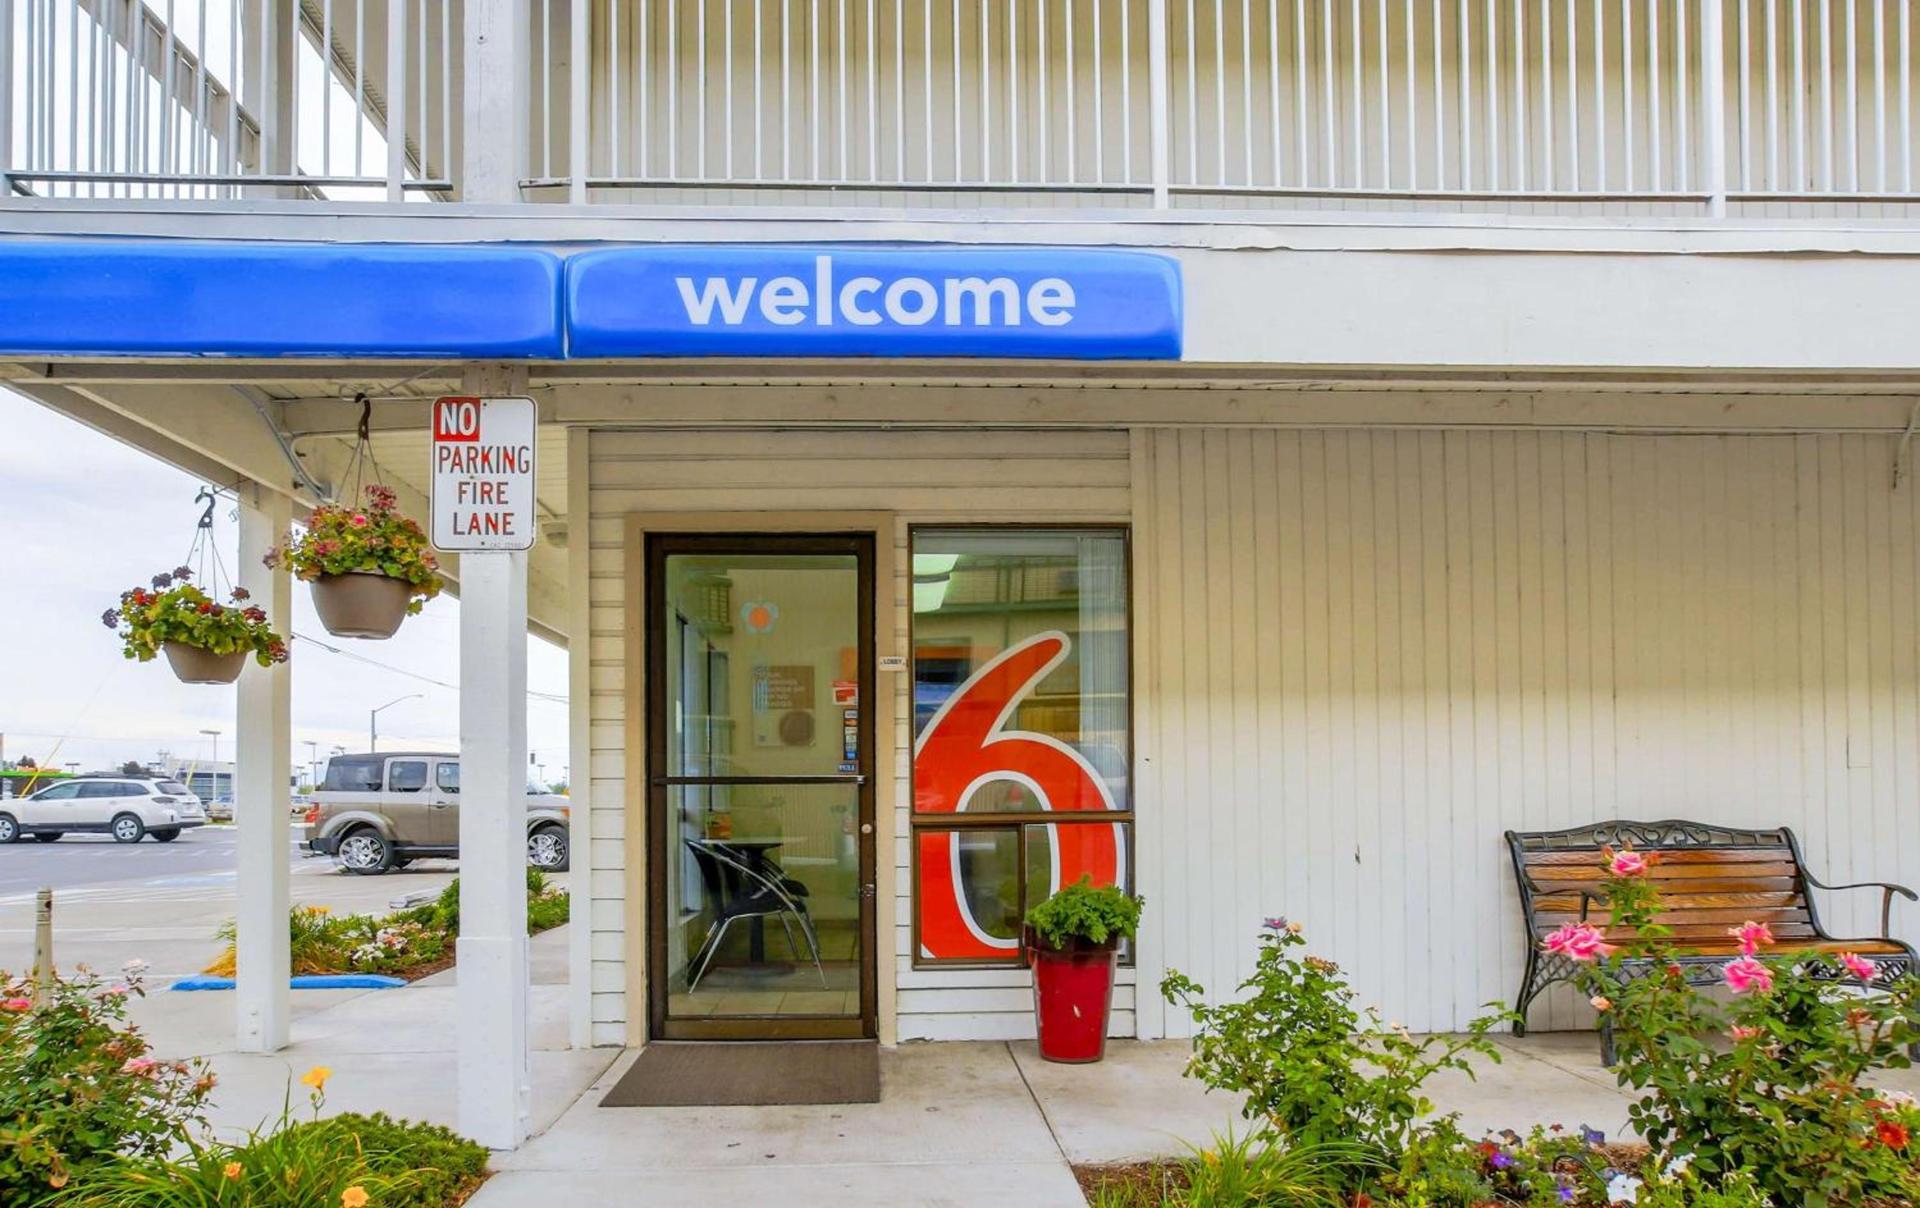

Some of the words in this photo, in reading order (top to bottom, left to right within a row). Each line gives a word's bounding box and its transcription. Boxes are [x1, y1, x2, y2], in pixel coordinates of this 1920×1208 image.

[676, 255, 1076, 326] welcome
[440, 402, 477, 436] NO
[438, 445, 530, 474] PARKING
[458, 481, 509, 505] FIRE
[453, 512, 515, 536] LANE
[914, 630, 1127, 960] 6
